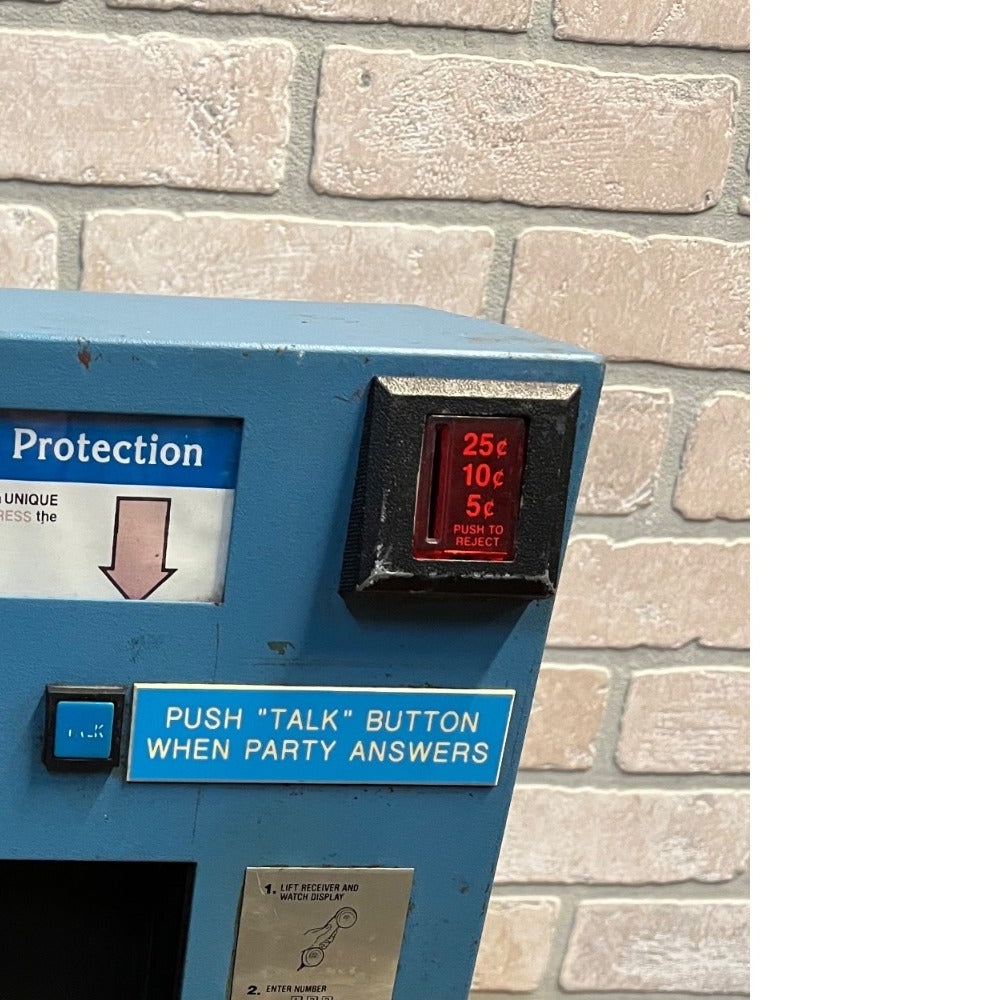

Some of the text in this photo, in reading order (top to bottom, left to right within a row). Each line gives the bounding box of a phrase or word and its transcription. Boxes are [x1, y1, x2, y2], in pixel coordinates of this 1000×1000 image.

[12, 427, 203, 467] Protection
[462, 433, 508, 458] 25¢
[462, 463, 504, 489] 10¢
[4, 493, 58, 506] UNIQUE
[466, 494, 494, 519] 5¢
[36, 510, 57, 524] the
[453, 525, 504, 534] PUSH TO
[456, 537, 500, 546] REJECT
[166, 706, 479, 733] PUSH "TALK" BUTTON
[147, 737, 489, 764] WHEN PARTY ANSWERS
[265, 883, 359, 894] 1. LIFT RECEIVER AND
[311, 893, 344, 901] DISPLAY
[247, 985, 327, 995] 2. ENTER NUMBER
